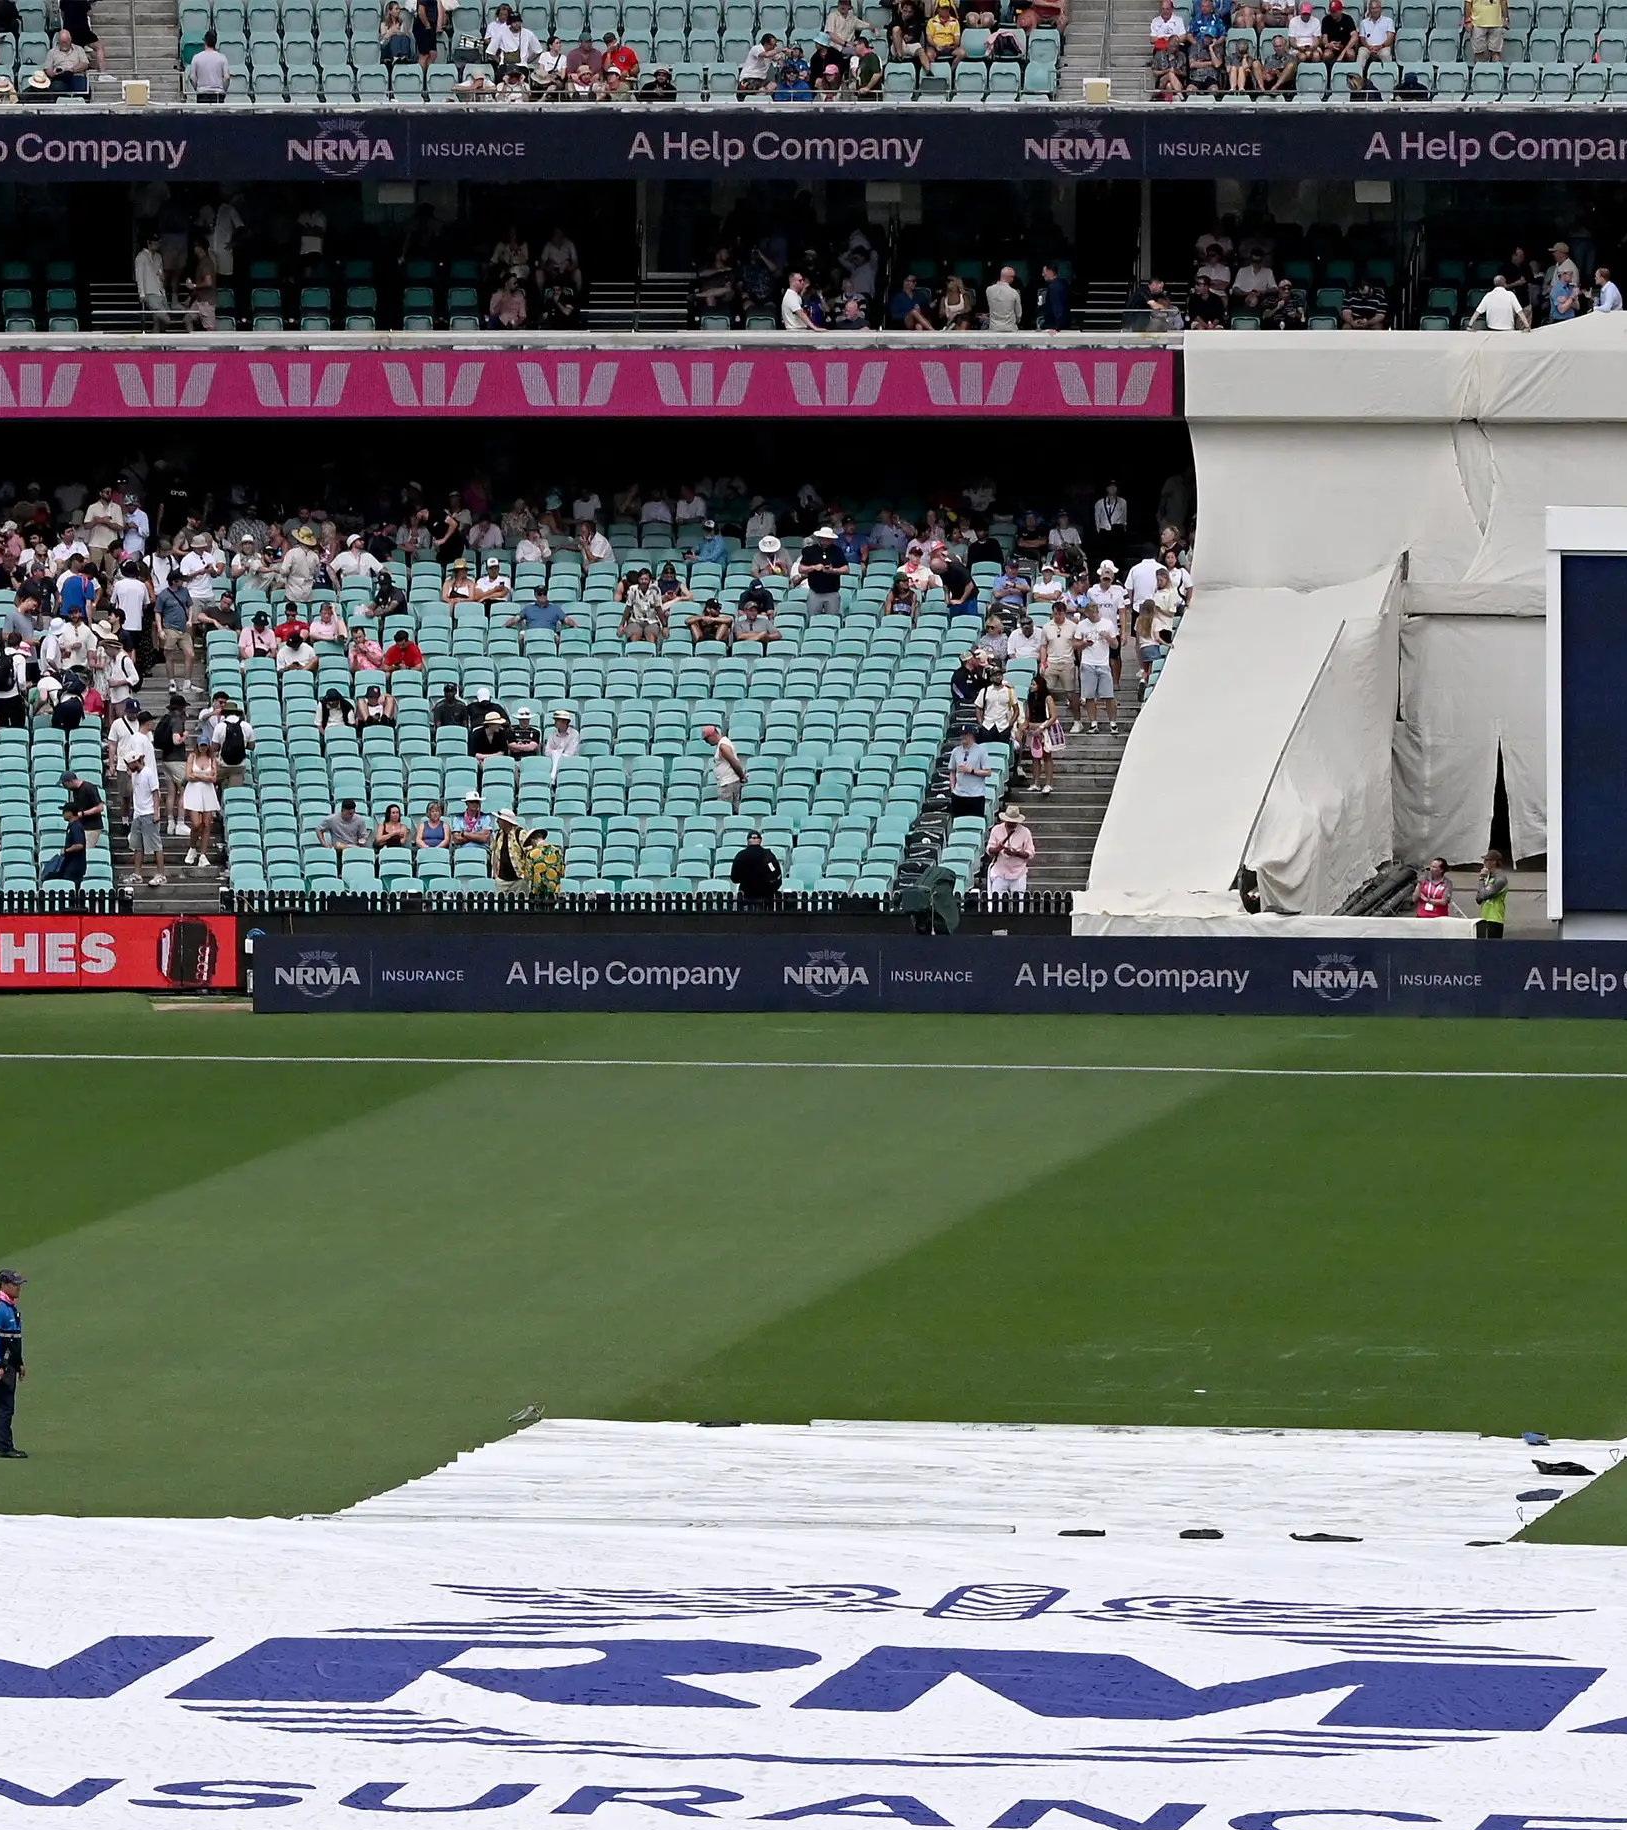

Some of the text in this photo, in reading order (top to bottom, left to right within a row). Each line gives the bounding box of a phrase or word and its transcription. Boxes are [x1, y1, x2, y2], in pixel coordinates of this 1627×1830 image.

[15, 134, 187, 169] Company
[288, 139, 525, 160] NRMA INSURANCE
[629, 131, 923, 167] A Help Company
[1025, 138, 1261, 159] NRMA INSURANCE
[1365, 132, 1390, 159] A
[1401, 131, 1480, 166] Help
[275, 966, 464, 985] NRMA INSURANCE
[506, 961, 741, 991] A Help Company
[784, 966, 973, 985] NRMA INSURANCE
[1015, 963, 1250, 994] A Help Company
[1292, 970, 1482, 989] NRMA INSURANCE
[1524, 968, 1546, 991] A
[1553, 967, 1618, 997] Help
